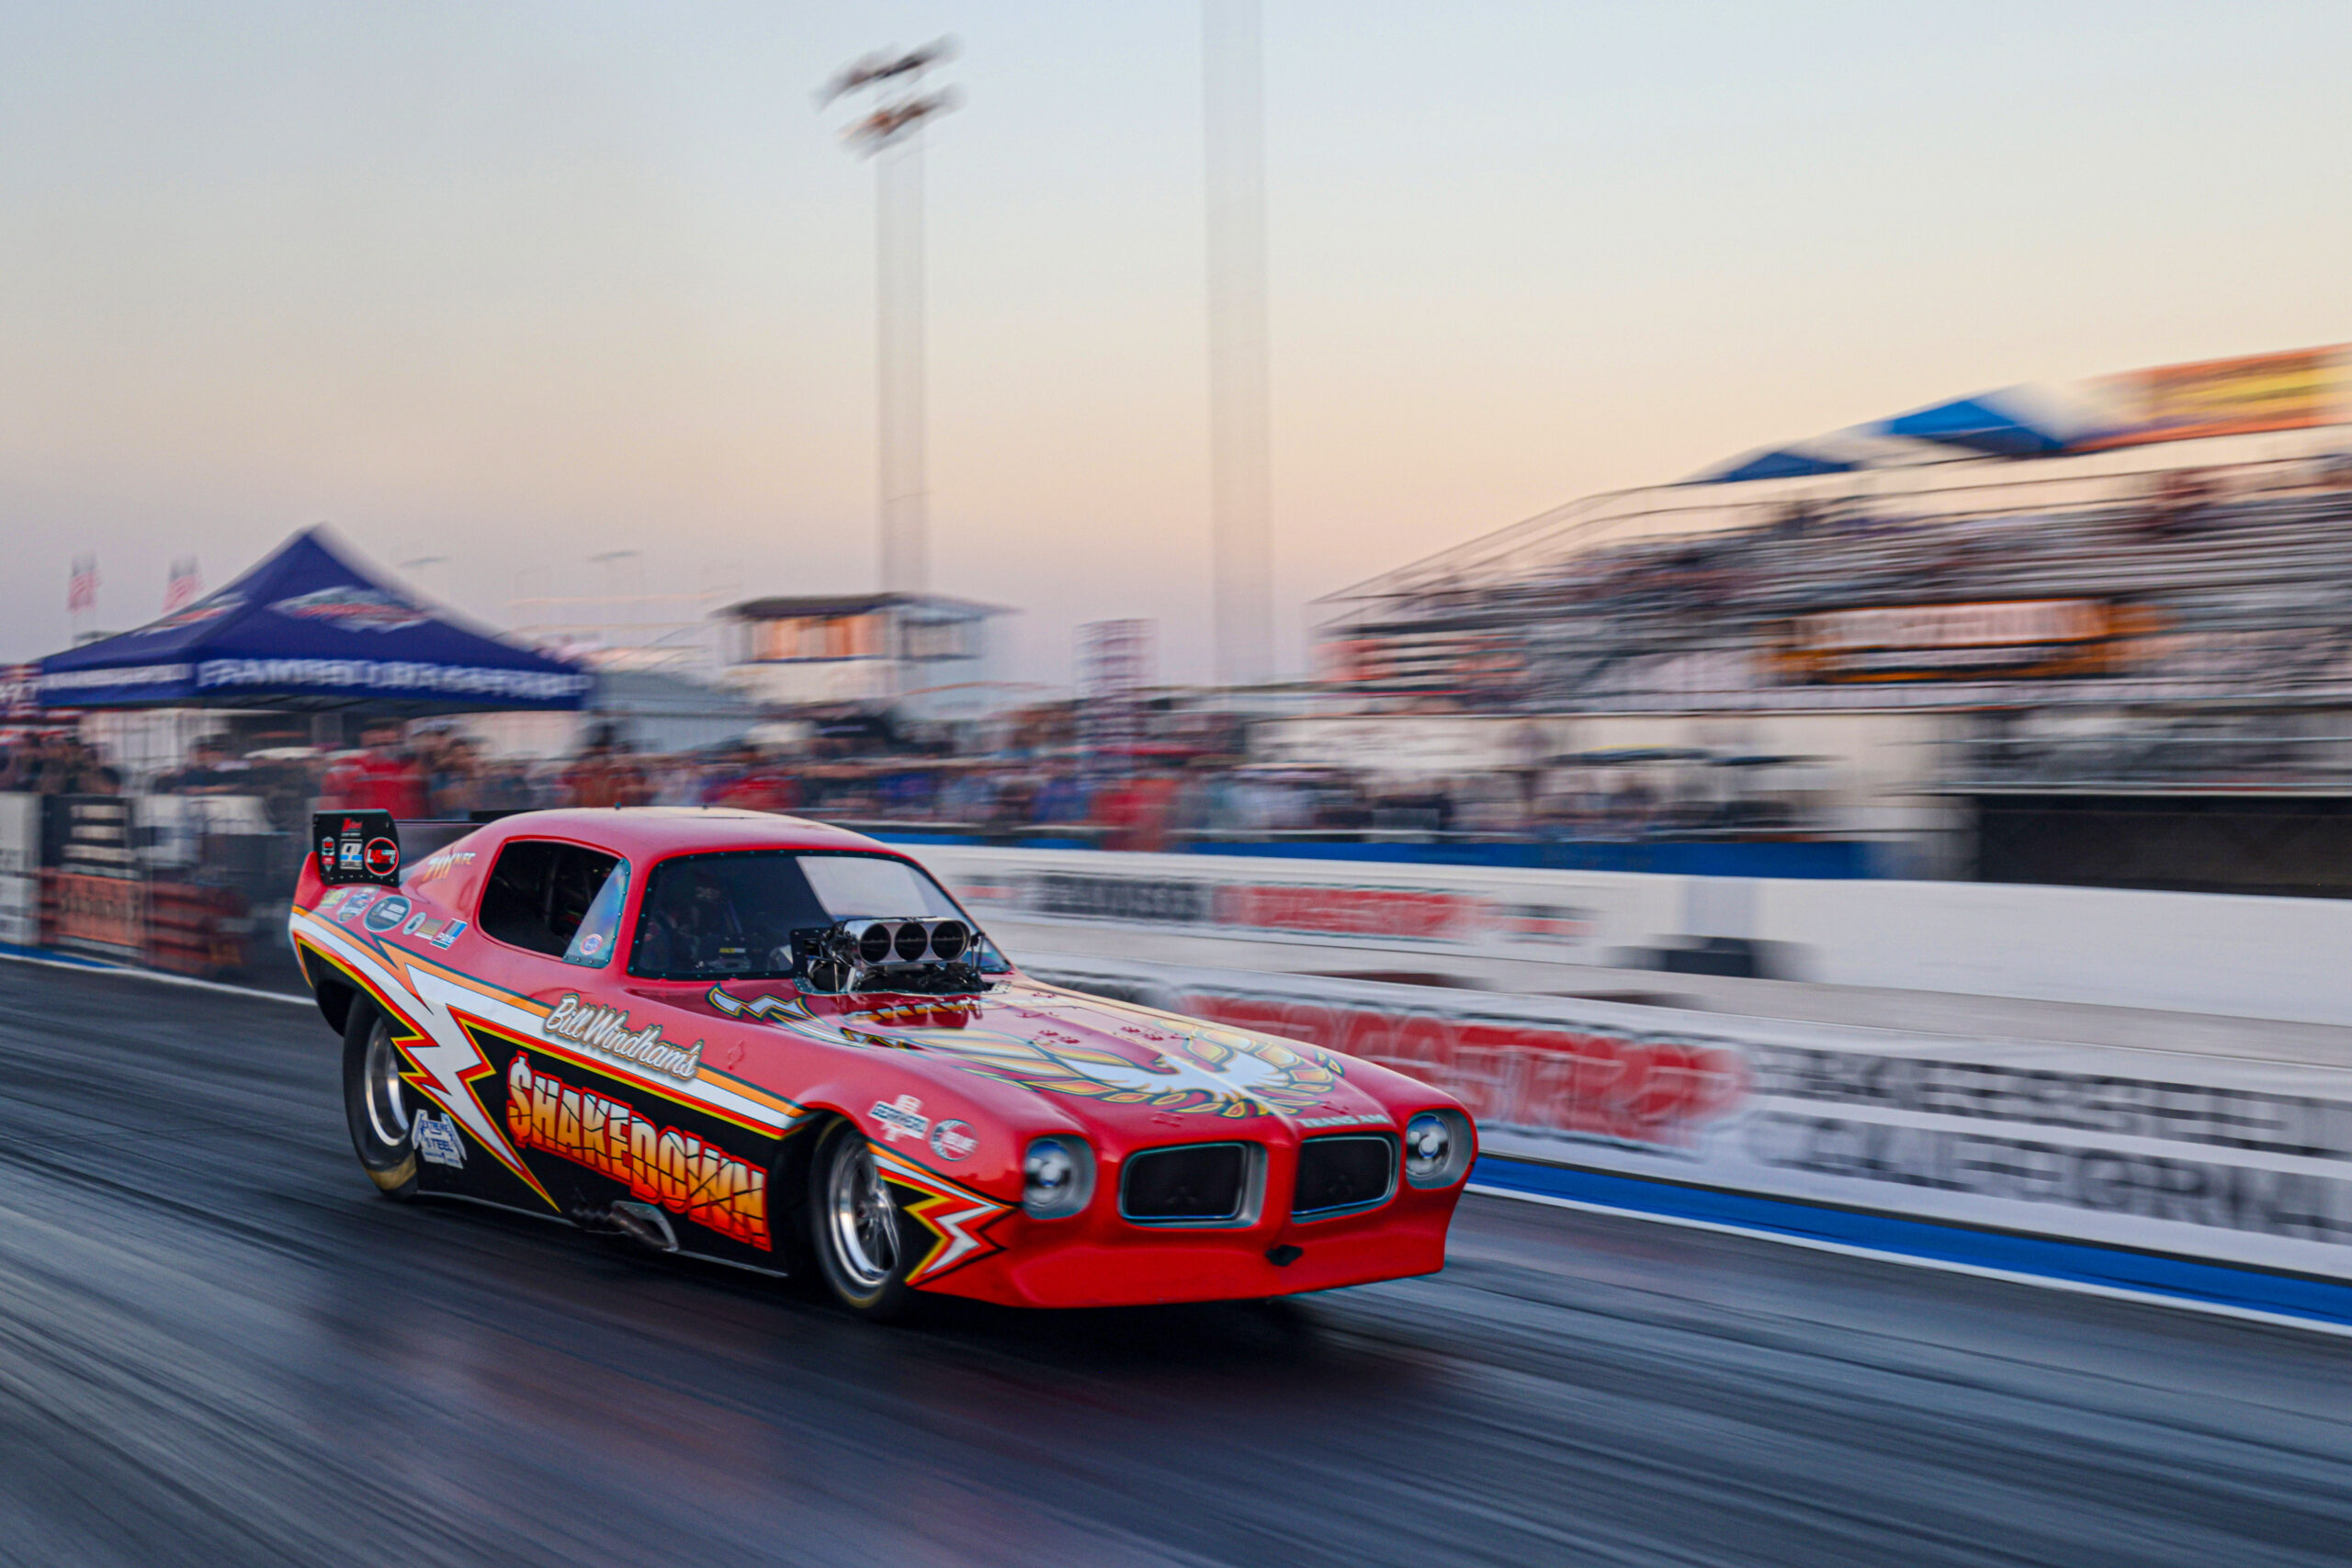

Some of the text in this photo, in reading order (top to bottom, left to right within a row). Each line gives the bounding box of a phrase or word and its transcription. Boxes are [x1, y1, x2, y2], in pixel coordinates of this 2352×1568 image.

[544, 994, 705, 1080] Bill Windham's
[1295, 1114, 1390, 1128] TRANS AM
